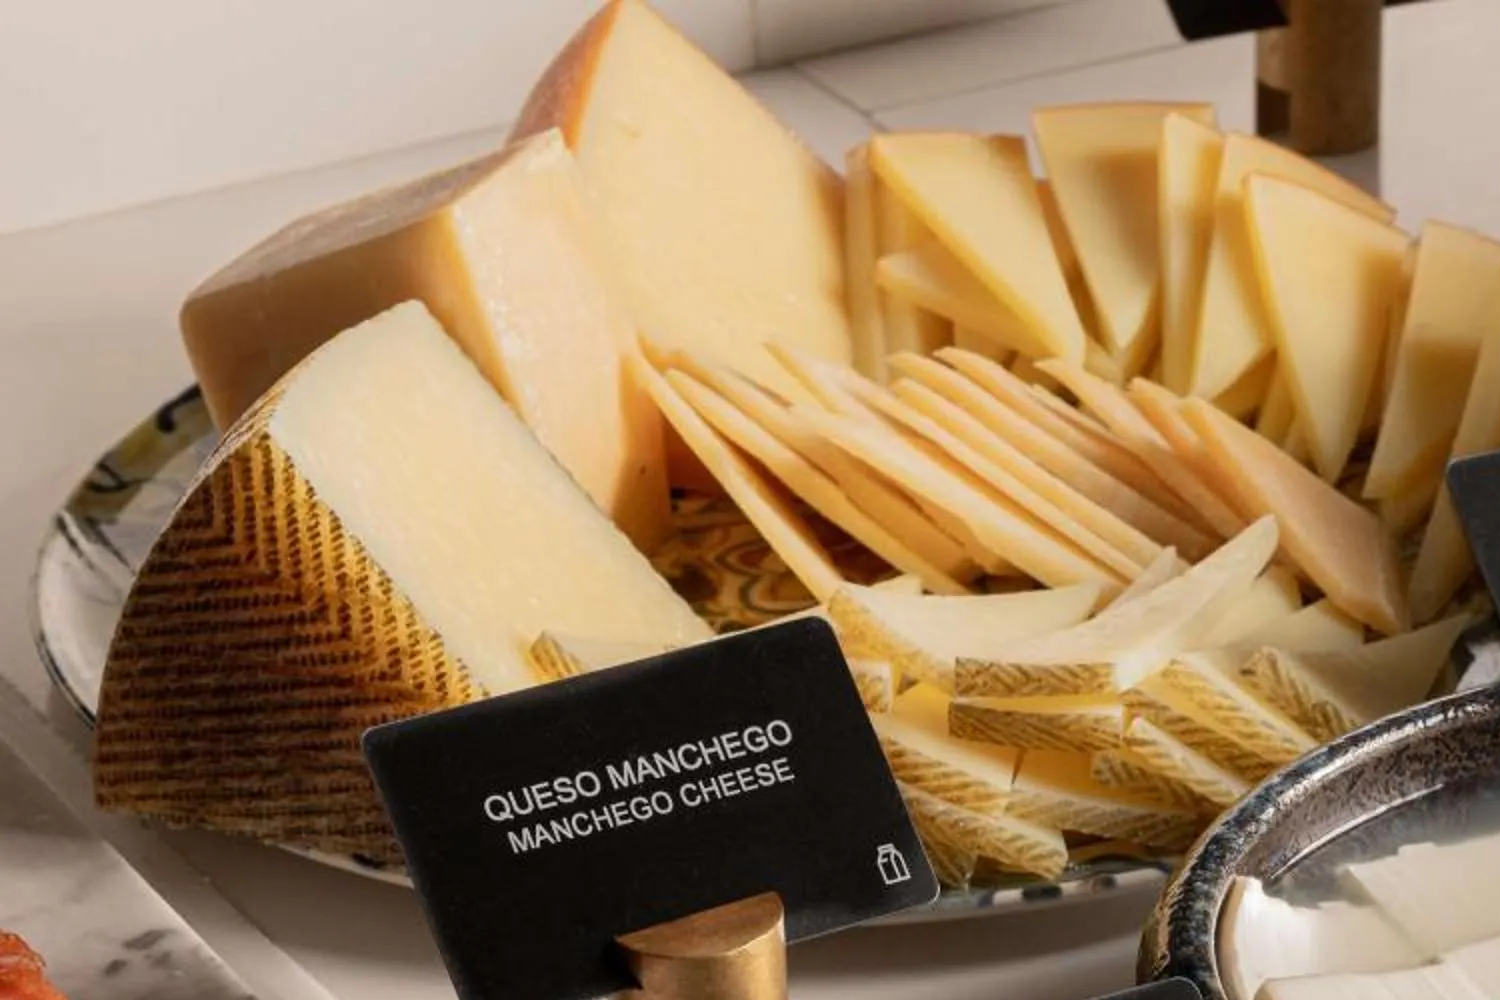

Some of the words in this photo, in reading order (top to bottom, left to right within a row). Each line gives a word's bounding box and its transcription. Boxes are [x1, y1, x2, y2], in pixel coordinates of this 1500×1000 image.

[484, 771, 601, 823] QUESO
[605, 719, 793, 791] MANCHEGO
[507, 790, 674, 854] MANCHEGO
[679, 757, 795, 807] CHEESE
